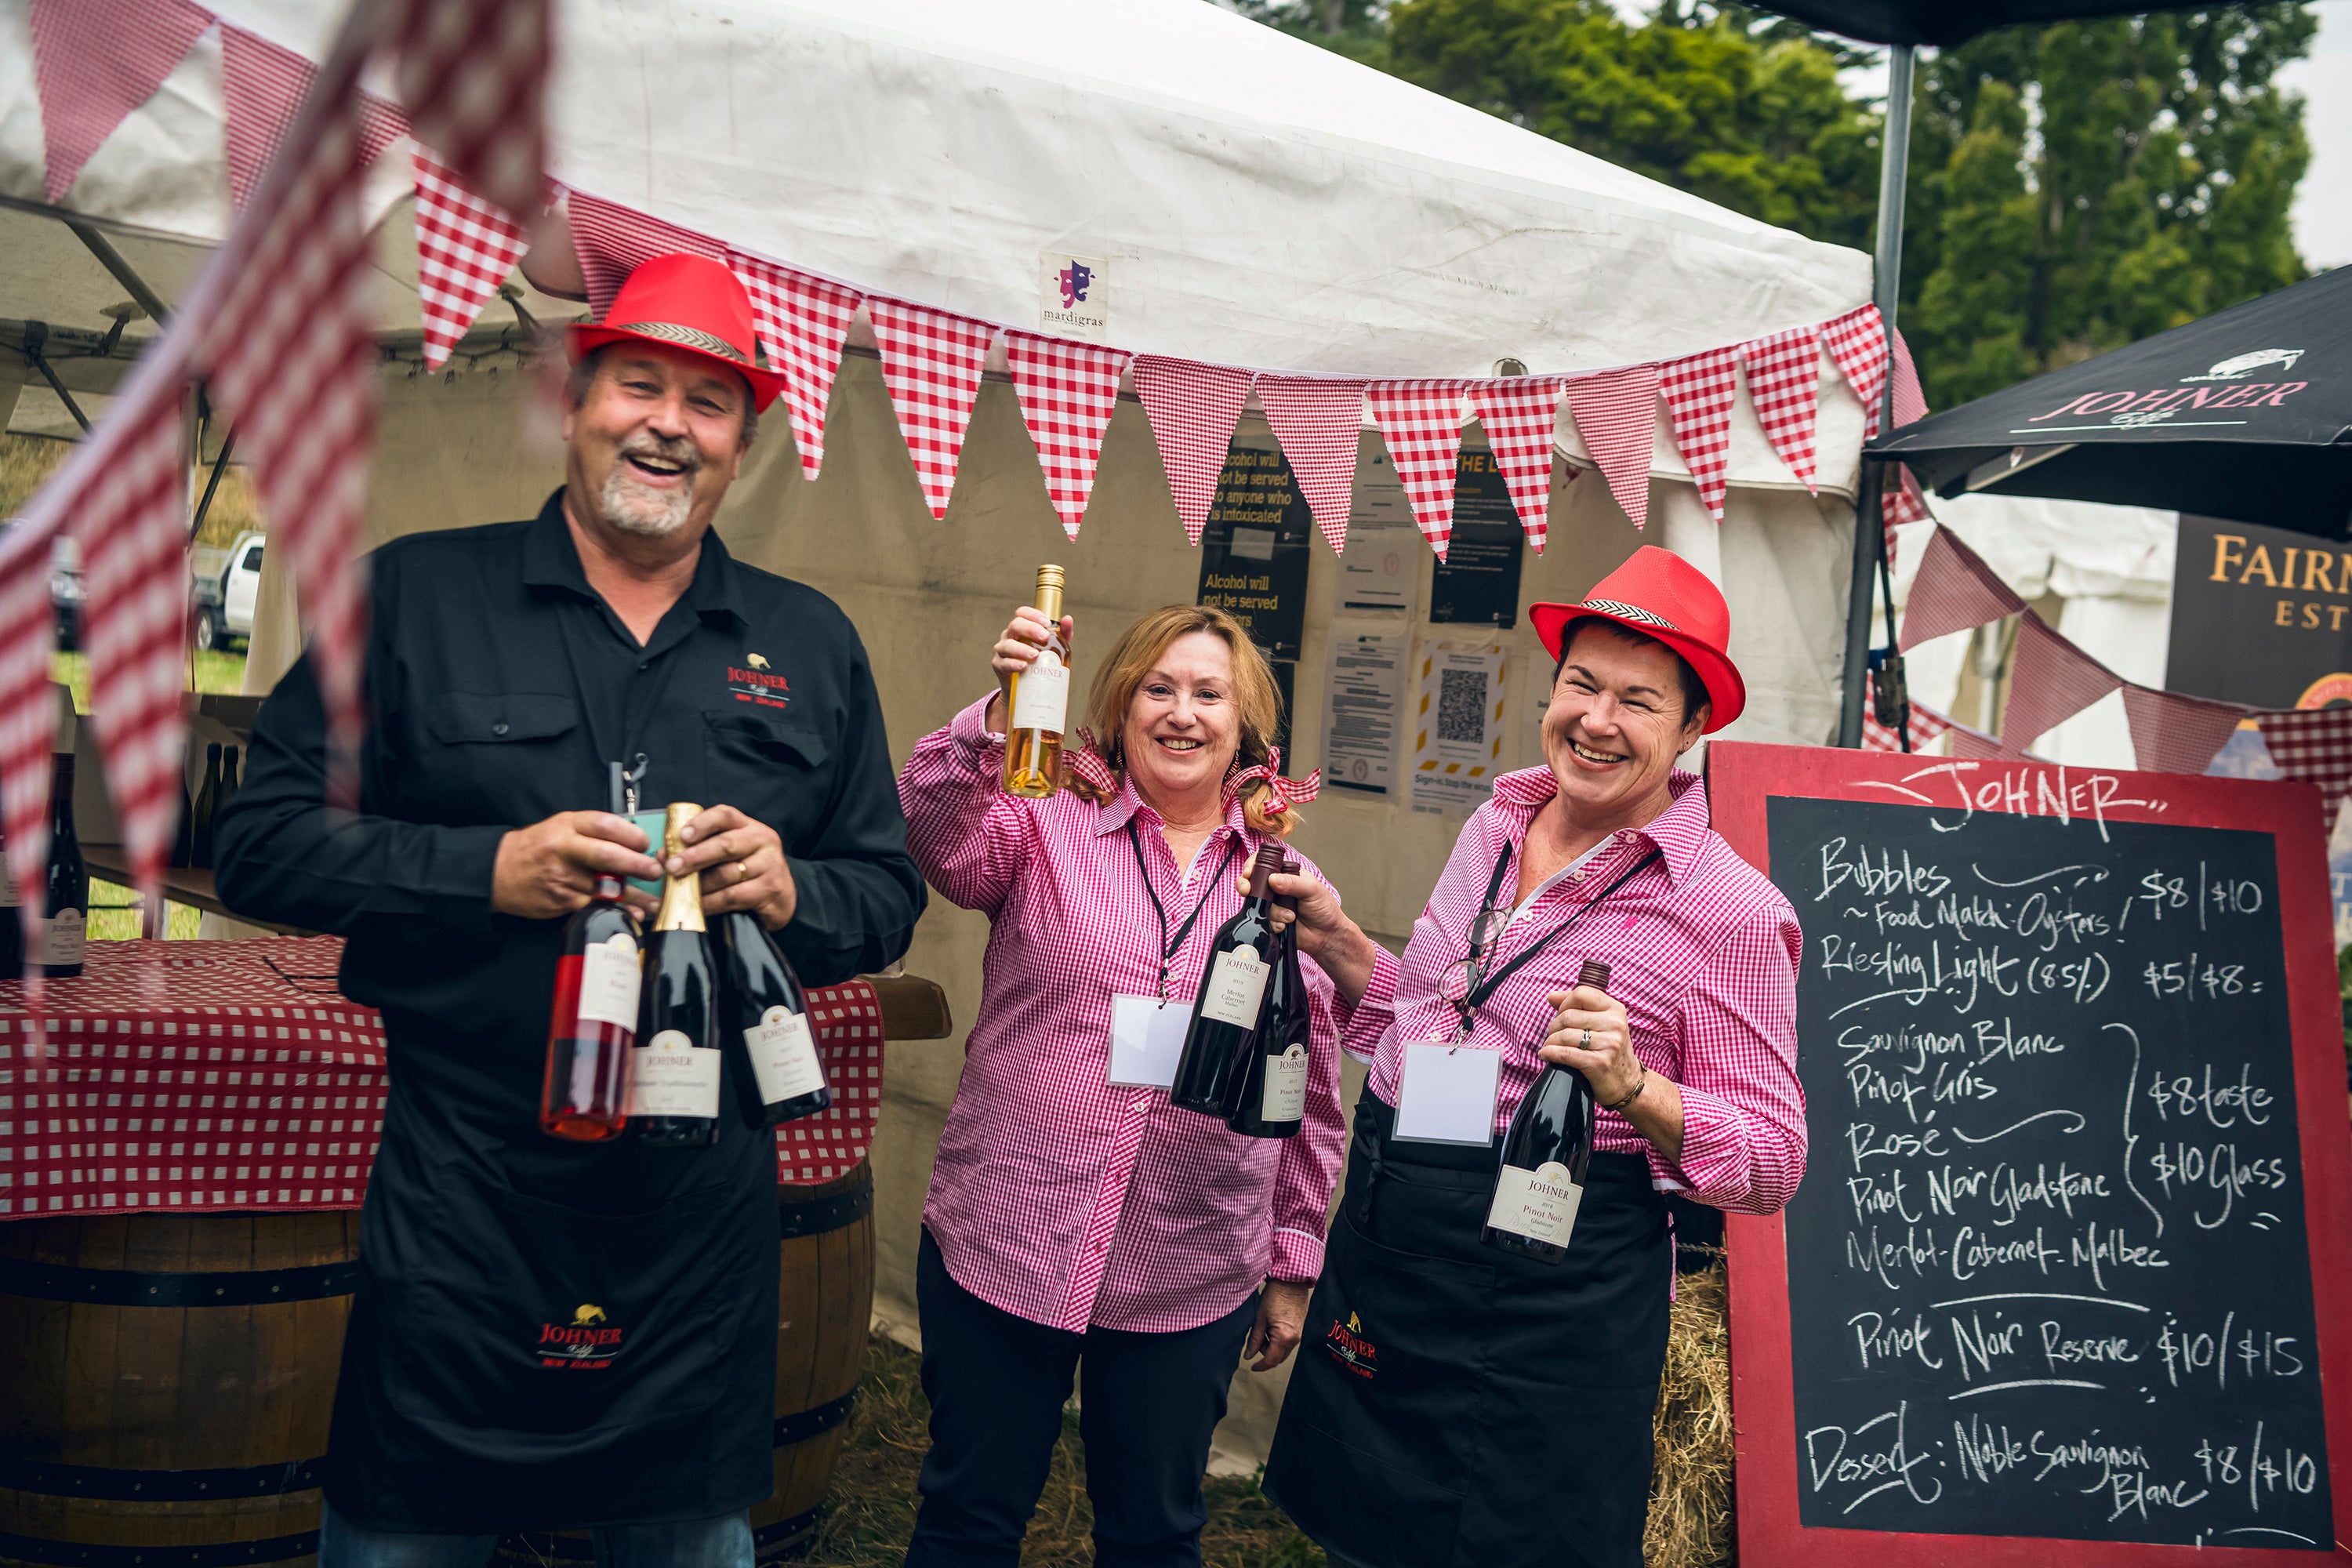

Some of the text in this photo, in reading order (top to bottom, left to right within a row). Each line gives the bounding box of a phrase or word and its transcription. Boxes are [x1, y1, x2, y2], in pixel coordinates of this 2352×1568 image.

[1044, 310, 1104, 327] mardigras
[2028, 381, 2309, 423] JOHNER
[1223, 451, 1280, 467] cohol will
[1234, 470, 1248, 485] be
[1250, 472, 1290, 486] served
[1214, 490, 1292, 506] o anyone who
[1222, 506, 1283, 524] intoxicated
[1205, 573, 1269, 591] Alcohol will
[1224, 593, 1237, 608] be
[1240, 595, 1279, 610] served
[727, 666, 790, 691] JOHNER
[1029, 666, 1062, 678] JOHNER
[1901, 762, 2147, 843] JOHNER
[1814, 837, 1952, 902] Bubbles
[1875, 900, 1935, 936] Food
[1225, 958, 1259, 975] JOHNER
[1820, 935, 1929, 1006] Riesling
[1932, 940, 2020, 1014] Light
[1221, 994, 1245, 1005] Cabernet
[1227, 989, 1245, 999] Merlot
[1838, 1017, 2065, 1075] Sauvignon Blanc
[646, 1056, 693, 1067] JOHNER
[1279, 1060, 1305, 1071] JOHNER
[1847, 1061, 1998, 1123] Pinot Gris
[1845, 1109, 1950, 1173] Rosé
[1528, 1179, 1569, 1201] JOHNER
[1846, 1162, 2111, 1226] Pinot Noir Gladstone
[1523, 1204, 1563, 1224] Pinot Noir
[538, 1323, 622, 1345] JOHNER
[1327, 1319, 1378, 1362] JOHNER
[1847, 1308, 1944, 1370] Pinot
[1951, 1309, 2023, 1381] Noir
[2040, 1320, 2140, 1373] Reserve
[1955, 1413, 2027, 1483] Noble
[2031, 1429, 2151, 1494] Sauvignon
[2107, 1472, 2209, 1523] Blanc
